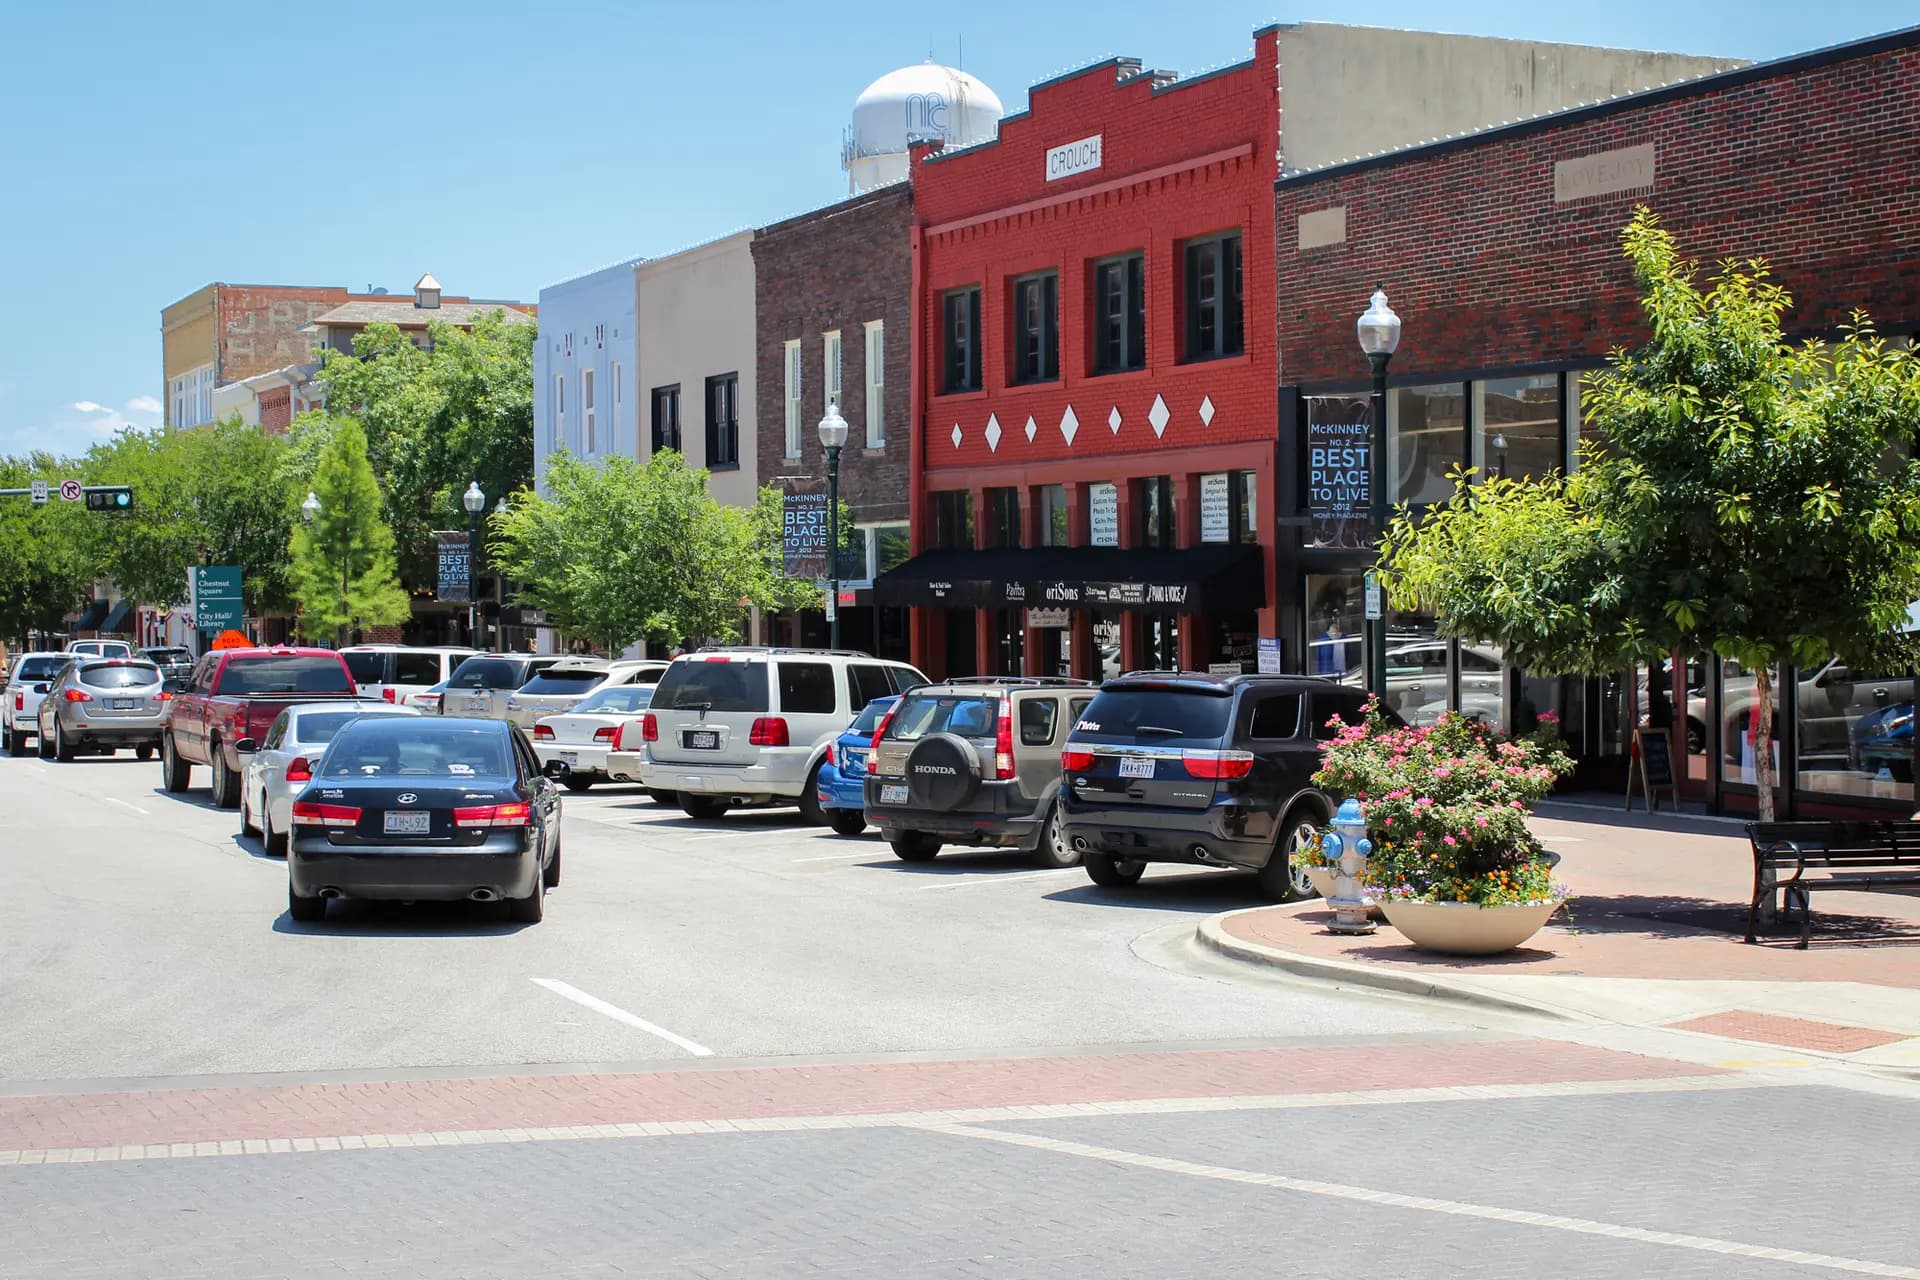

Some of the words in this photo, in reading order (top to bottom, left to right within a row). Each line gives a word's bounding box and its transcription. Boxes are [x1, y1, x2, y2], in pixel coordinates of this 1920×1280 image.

[1051, 141, 1098, 174] CROUCH
[1311, 423, 1370, 434] McKINNEY
[1312, 448, 1368, 468] BEST
[1312, 470, 1368, 485] PLACE
[784, 494, 827, 502] McKINNEY
[1311, 488, 1332, 500] TO
[1336, 488, 1368, 500] LIVE
[785, 511, 826, 524] BEST
[784, 526, 826, 536] PLACE
[784, 538, 800, 547] TO
[803, 538, 826, 546] LIVE
[440, 555, 469, 564] BEST
[1046, 582, 1078, 600] oriSons
[915, 765, 957, 775] HONDA
